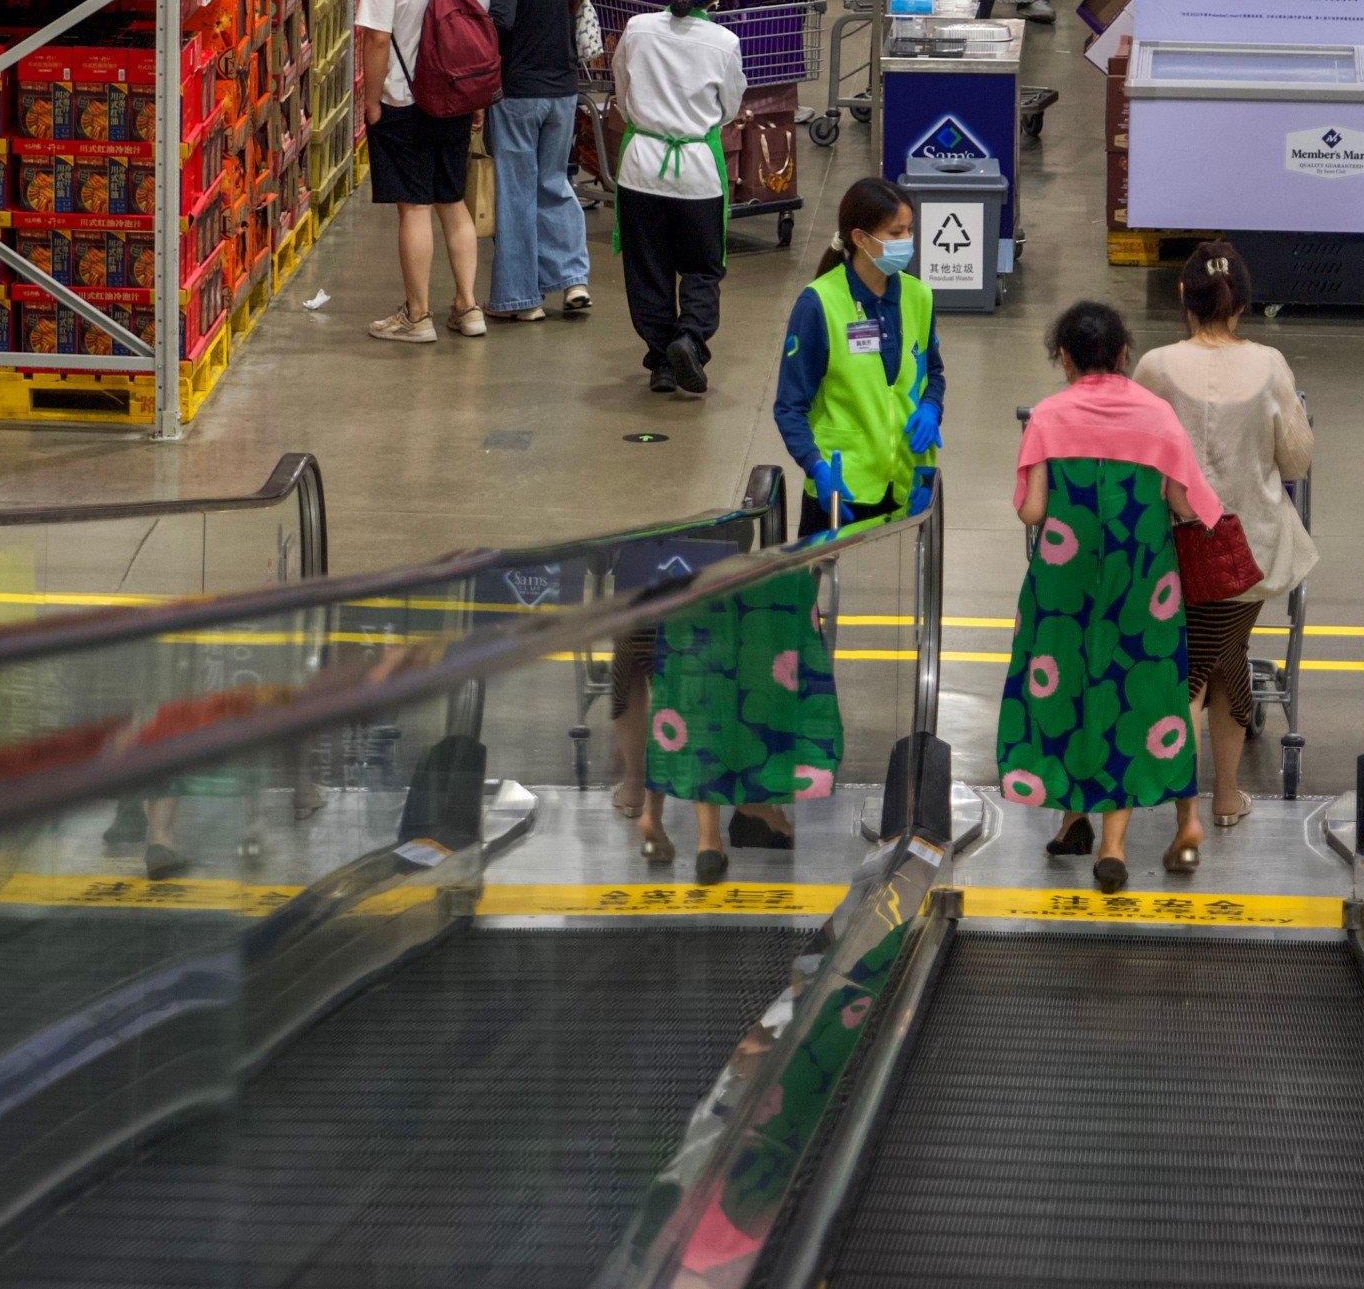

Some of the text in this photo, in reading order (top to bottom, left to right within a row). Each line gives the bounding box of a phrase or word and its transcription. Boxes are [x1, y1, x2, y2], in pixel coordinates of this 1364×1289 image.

[1291, 148, 1341, 161] Member's
[929, 263, 974, 273] 其他垃圾
[1049, 895, 1245, 910] 注意安全
[1227, 916, 1294, 924] Stay
